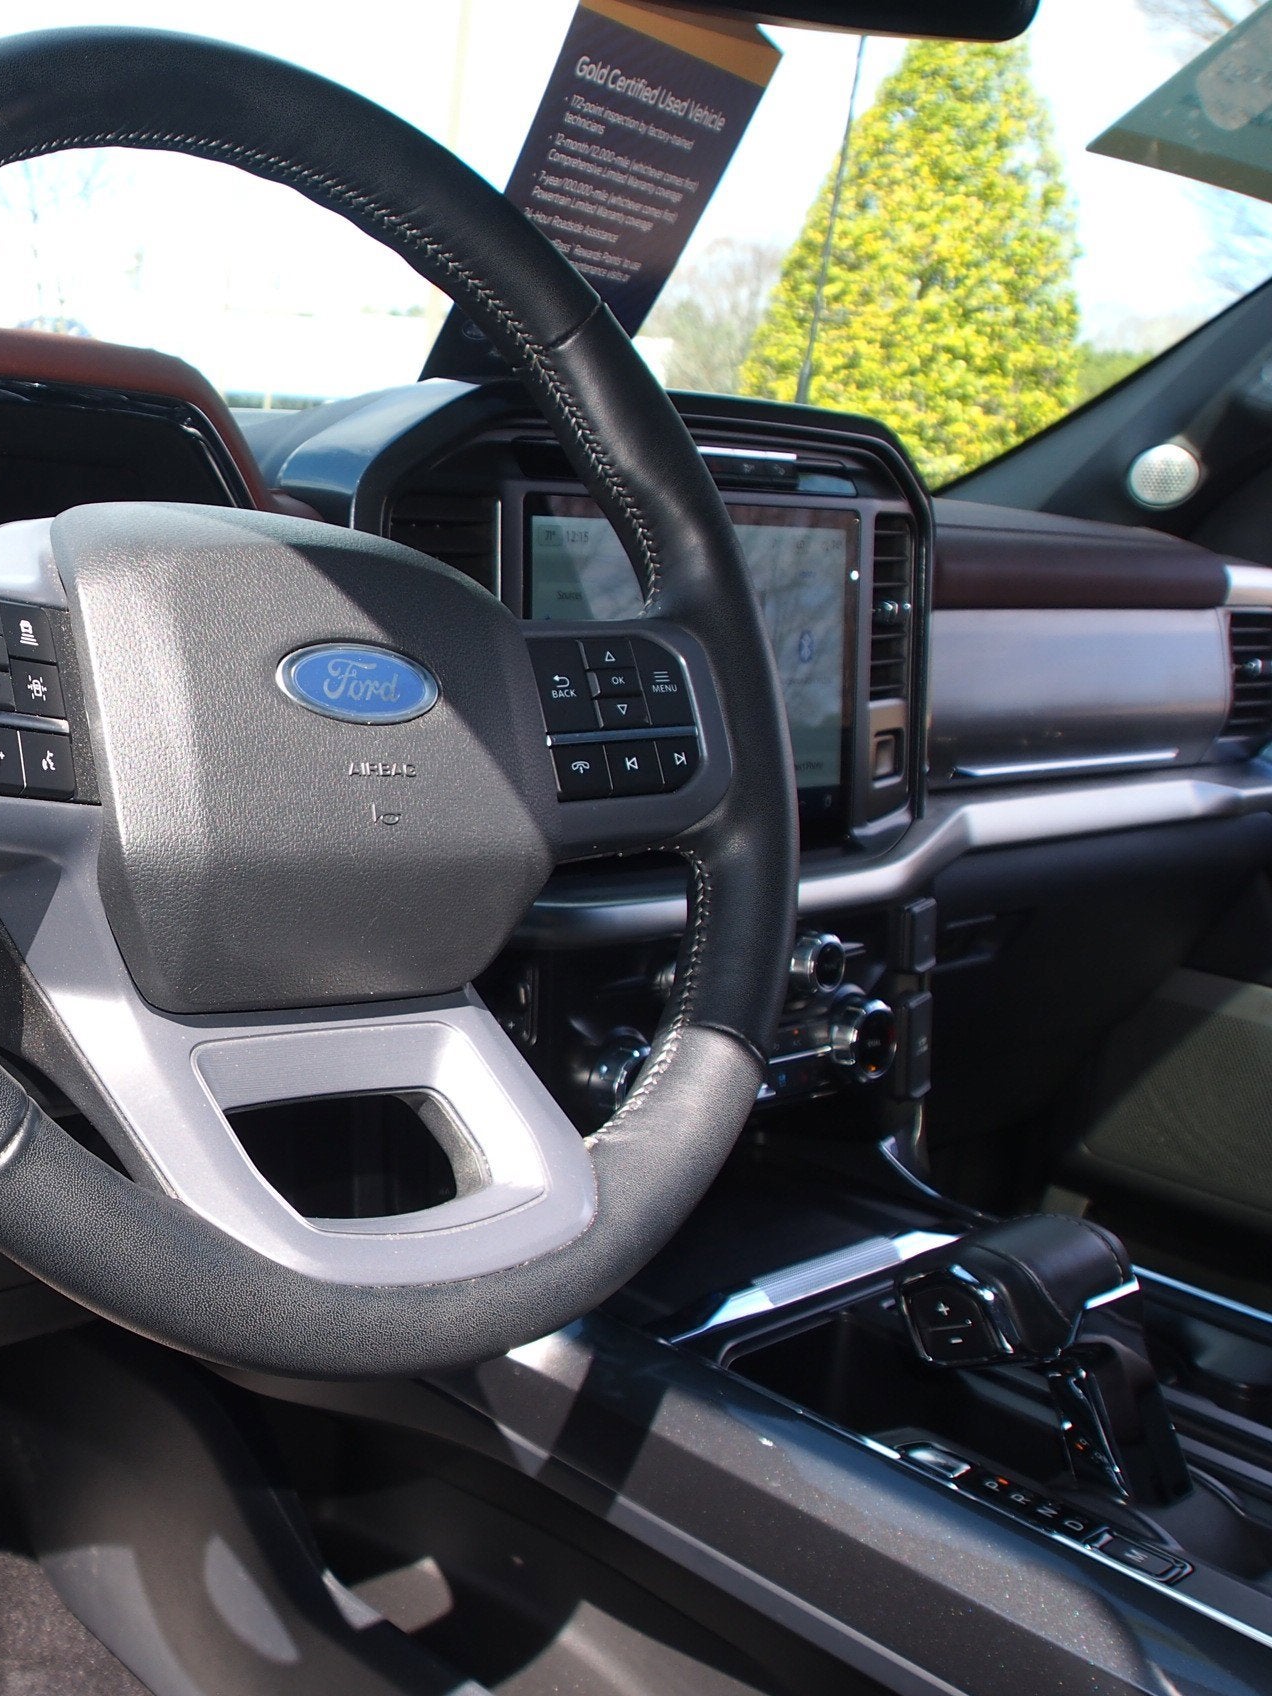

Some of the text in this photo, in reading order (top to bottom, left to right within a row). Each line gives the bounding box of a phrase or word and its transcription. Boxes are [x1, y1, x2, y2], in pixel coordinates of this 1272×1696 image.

[576, 55, 726, 131] Gold Certified Used Vehicle
[564, 111, 606, 135] technicians
[603, 107, 639, 130] inspection
[638, 120, 648, 135] by
[548, 148, 603, 176] Comprehensive
[602, 165, 628, 184] Limited
[532, 185, 572, 205] Powertrain
[571, 195, 597, 214] Limited
[551, 215, 584, 234] Roadside
[583, 225, 620, 244] Assistance
[323, 658, 399, 702] Ford
[611, 675, 625, 686] OK
[551, 688, 577, 699] BACK
[652, 683, 678, 694] MENU
[348, 761, 416, 777] AIRBAG
[985, 1480, 1000, 1492] P
[1010, 1493, 1030, 1505] R
[1036, 1505, 1059, 1518] N
[1064, 1520, 1085, 1532] D
[1124, 1549, 1149, 1563] M
